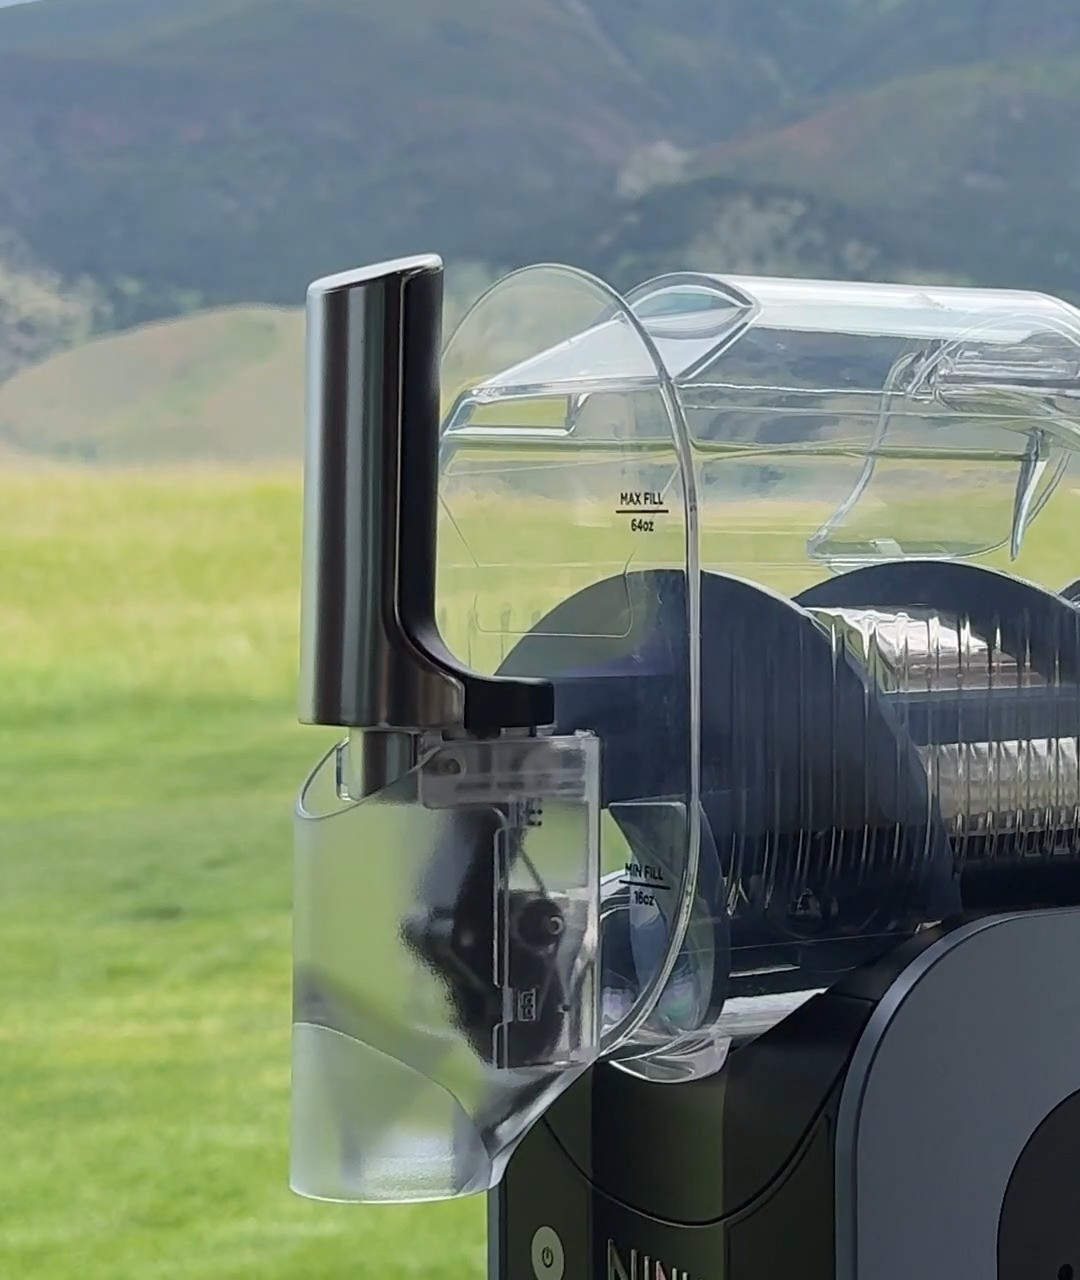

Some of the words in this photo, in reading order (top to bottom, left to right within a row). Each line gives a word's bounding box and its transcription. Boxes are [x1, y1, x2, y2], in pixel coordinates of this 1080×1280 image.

[620, 492, 641, 505] MAX
[644, 492, 664, 505] FILL
[631, 518, 654, 532] 64oz
[625, 862, 642, 878] MIN
[644, 865, 664, 880] FILL
[634, 890, 655, 906] 16oz
